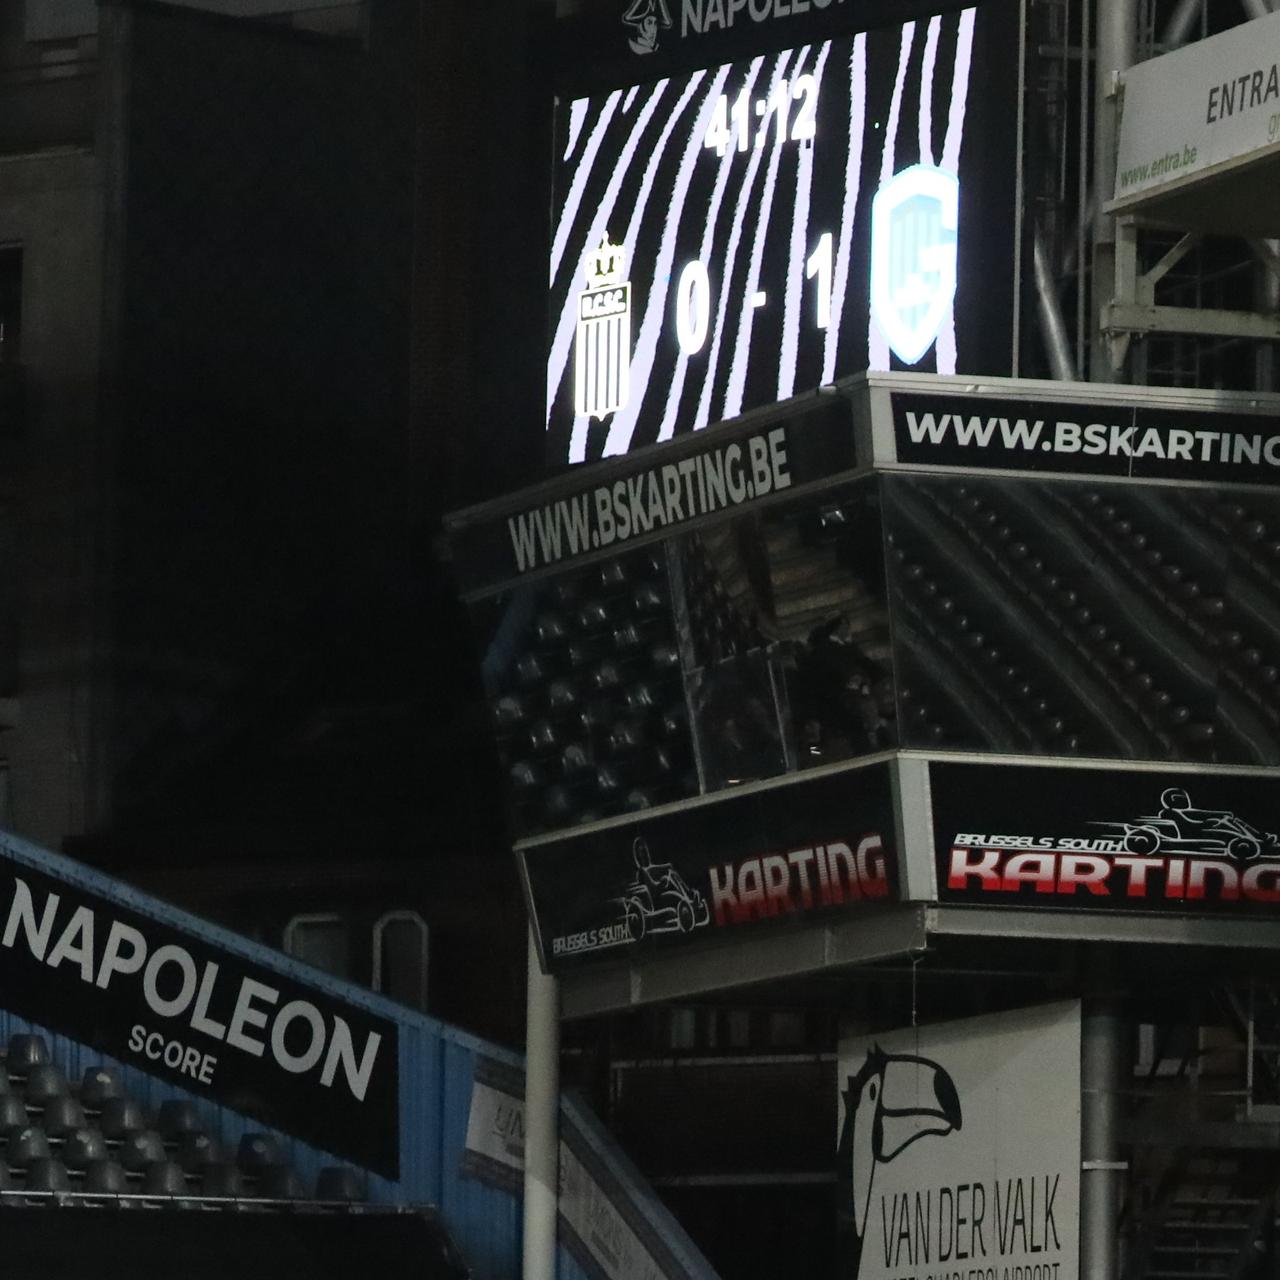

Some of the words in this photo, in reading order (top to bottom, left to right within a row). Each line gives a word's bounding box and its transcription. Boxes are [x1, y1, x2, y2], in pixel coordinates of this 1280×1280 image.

[704, 74, 817, 157] 41:12
[1206, 63, 1280, 125] ENTRA
[1120, 144, 1198, 188] www.entra.be
[677, 260, 710, 354] 0
[806, 232, 832, 328] 1
[508, 427, 791, 572] WWW.BSKARTING.BE
[711, 835, 889, 926] KARTING
[953, 833, 1053, 849] BRUSSELS
[1057, 838, 1126, 852] SOUTH
[2, 877, 382, 1101] NAPOLEON
[128, 1025, 218, 1085] SCORE
[881, 1191, 930, 1268] VAN
[938, 1182, 987, 1261] DER
[995, 1173, 1061, 1256] VALK
